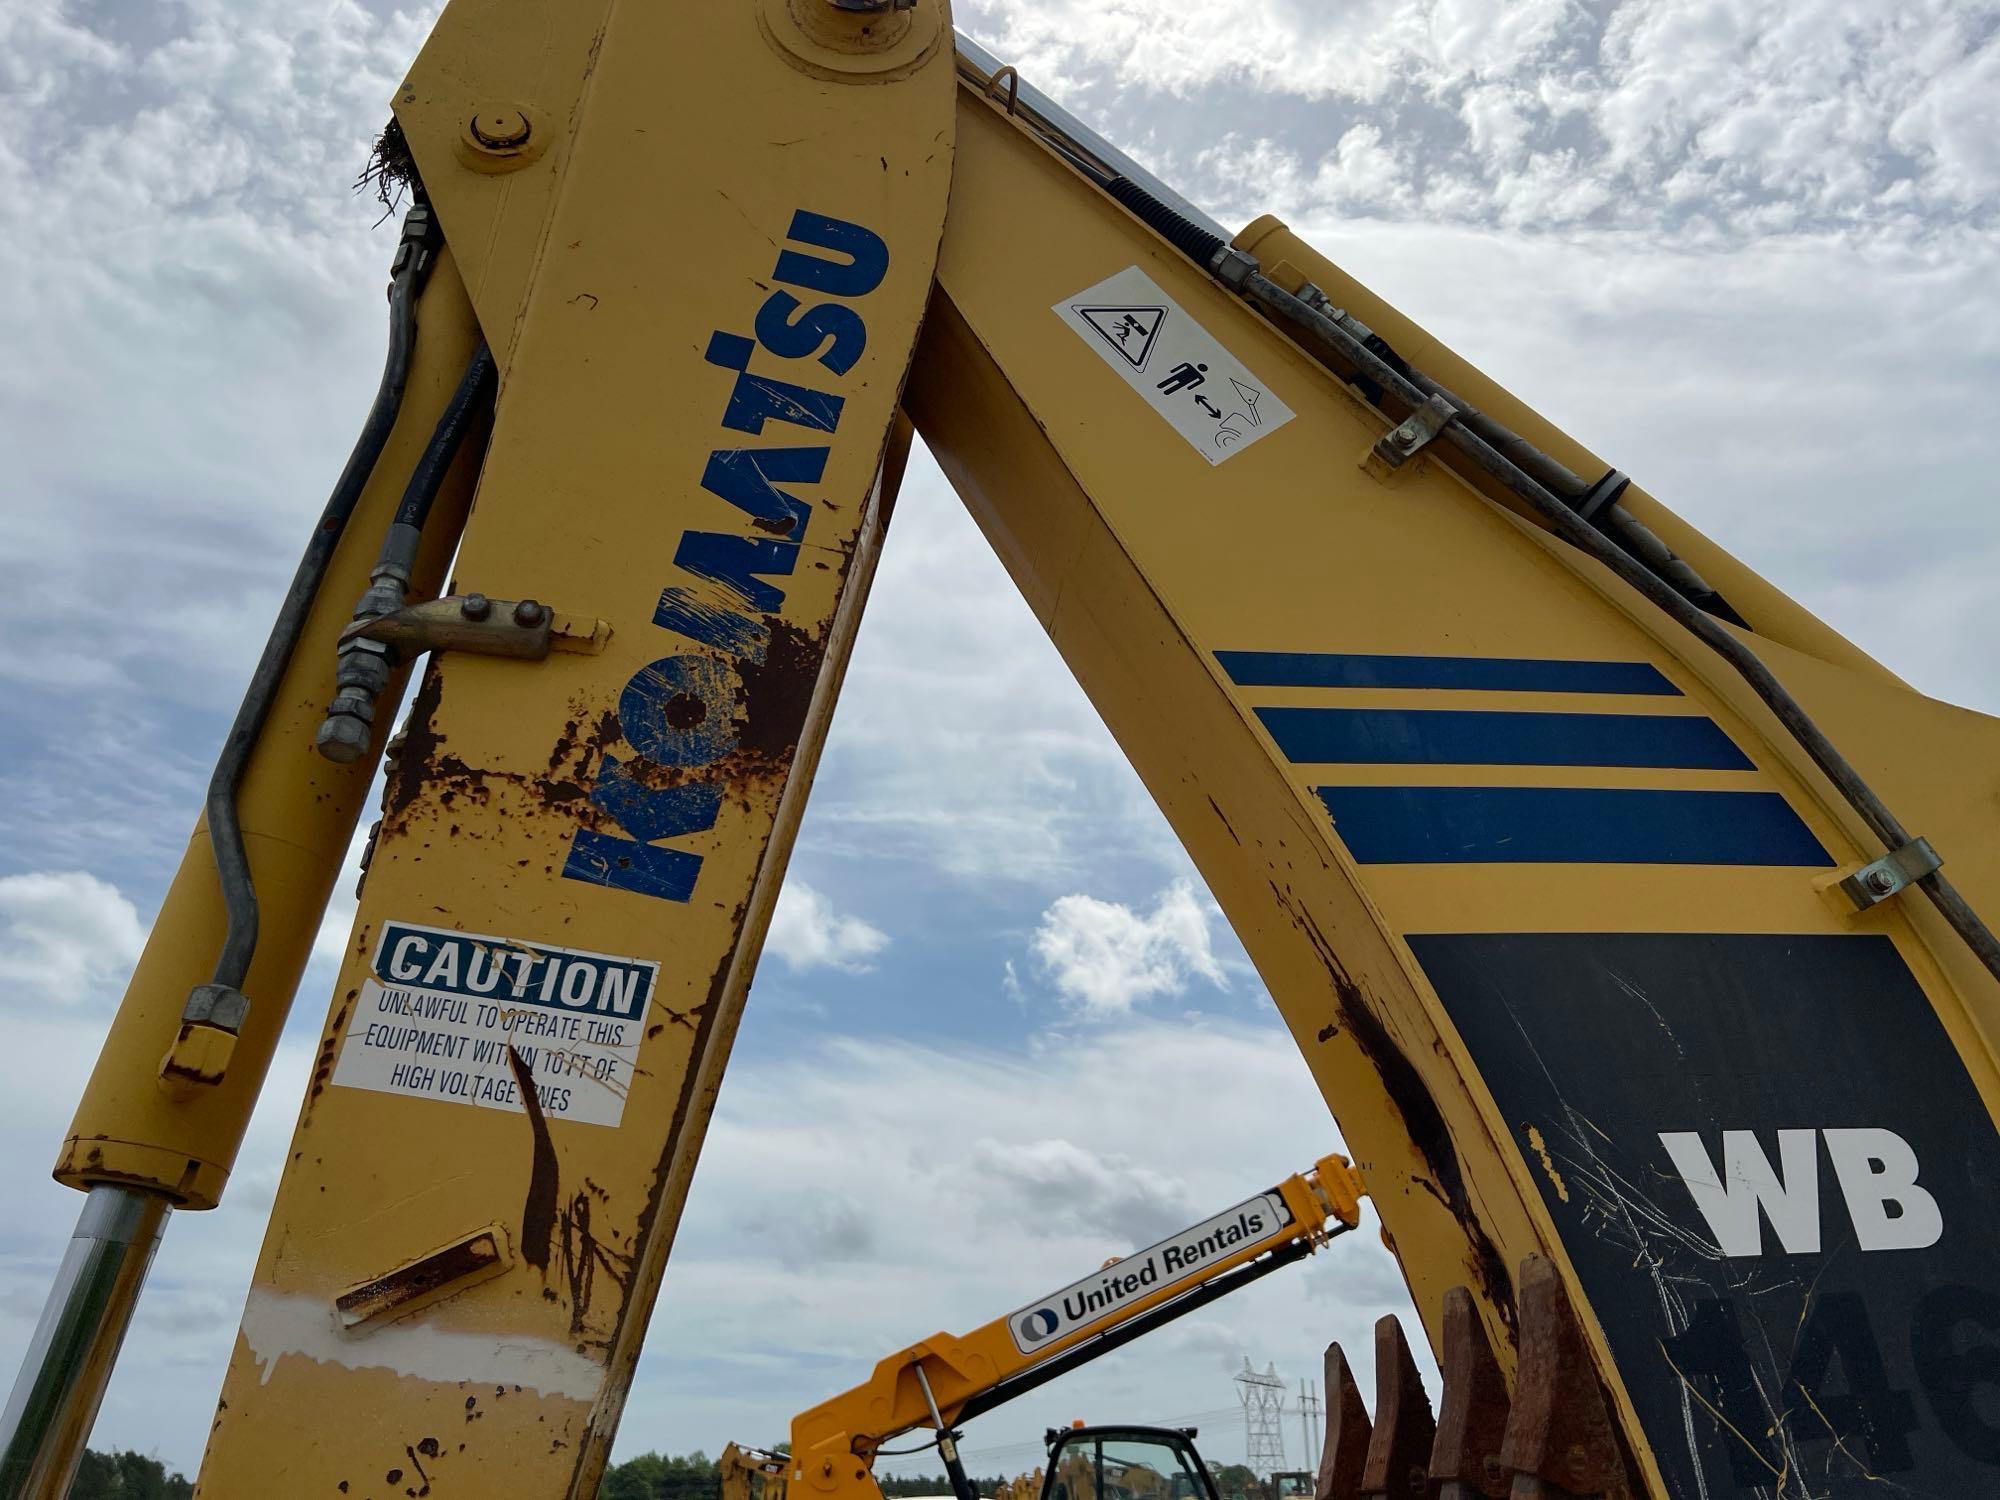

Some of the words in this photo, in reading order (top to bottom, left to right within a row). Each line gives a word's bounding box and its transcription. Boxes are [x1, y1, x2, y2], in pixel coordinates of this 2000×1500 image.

[561, 208, 890, 904] KOMATSU
[389, 935, 641, 1015] CAUTION
[364, 1023, 470, 1060] EQUIPMENT
[544, 1051, 566, 1075] 10
[566, 1053, 592, 1079] FT
[593, 1058, 618, 1082] OF
[378, 990, 468, 1025] UNLAWFUL
[476, 1004, 499, 1029] TO
[502, 1008, 582, 1041] OPERATE
[587, 1020, 625, 1046] THIS
[390, 1063, 437, 1092] HIGH
[439, 1070, 518, 1105] VOLTAGE
[520, 1084, 572, 1112] NES
[1657, 1128, 1944, 1258] WB
[1063, 1258, 1158, 1322] United
[1161, 1211, 1264, 1275] Rentals
